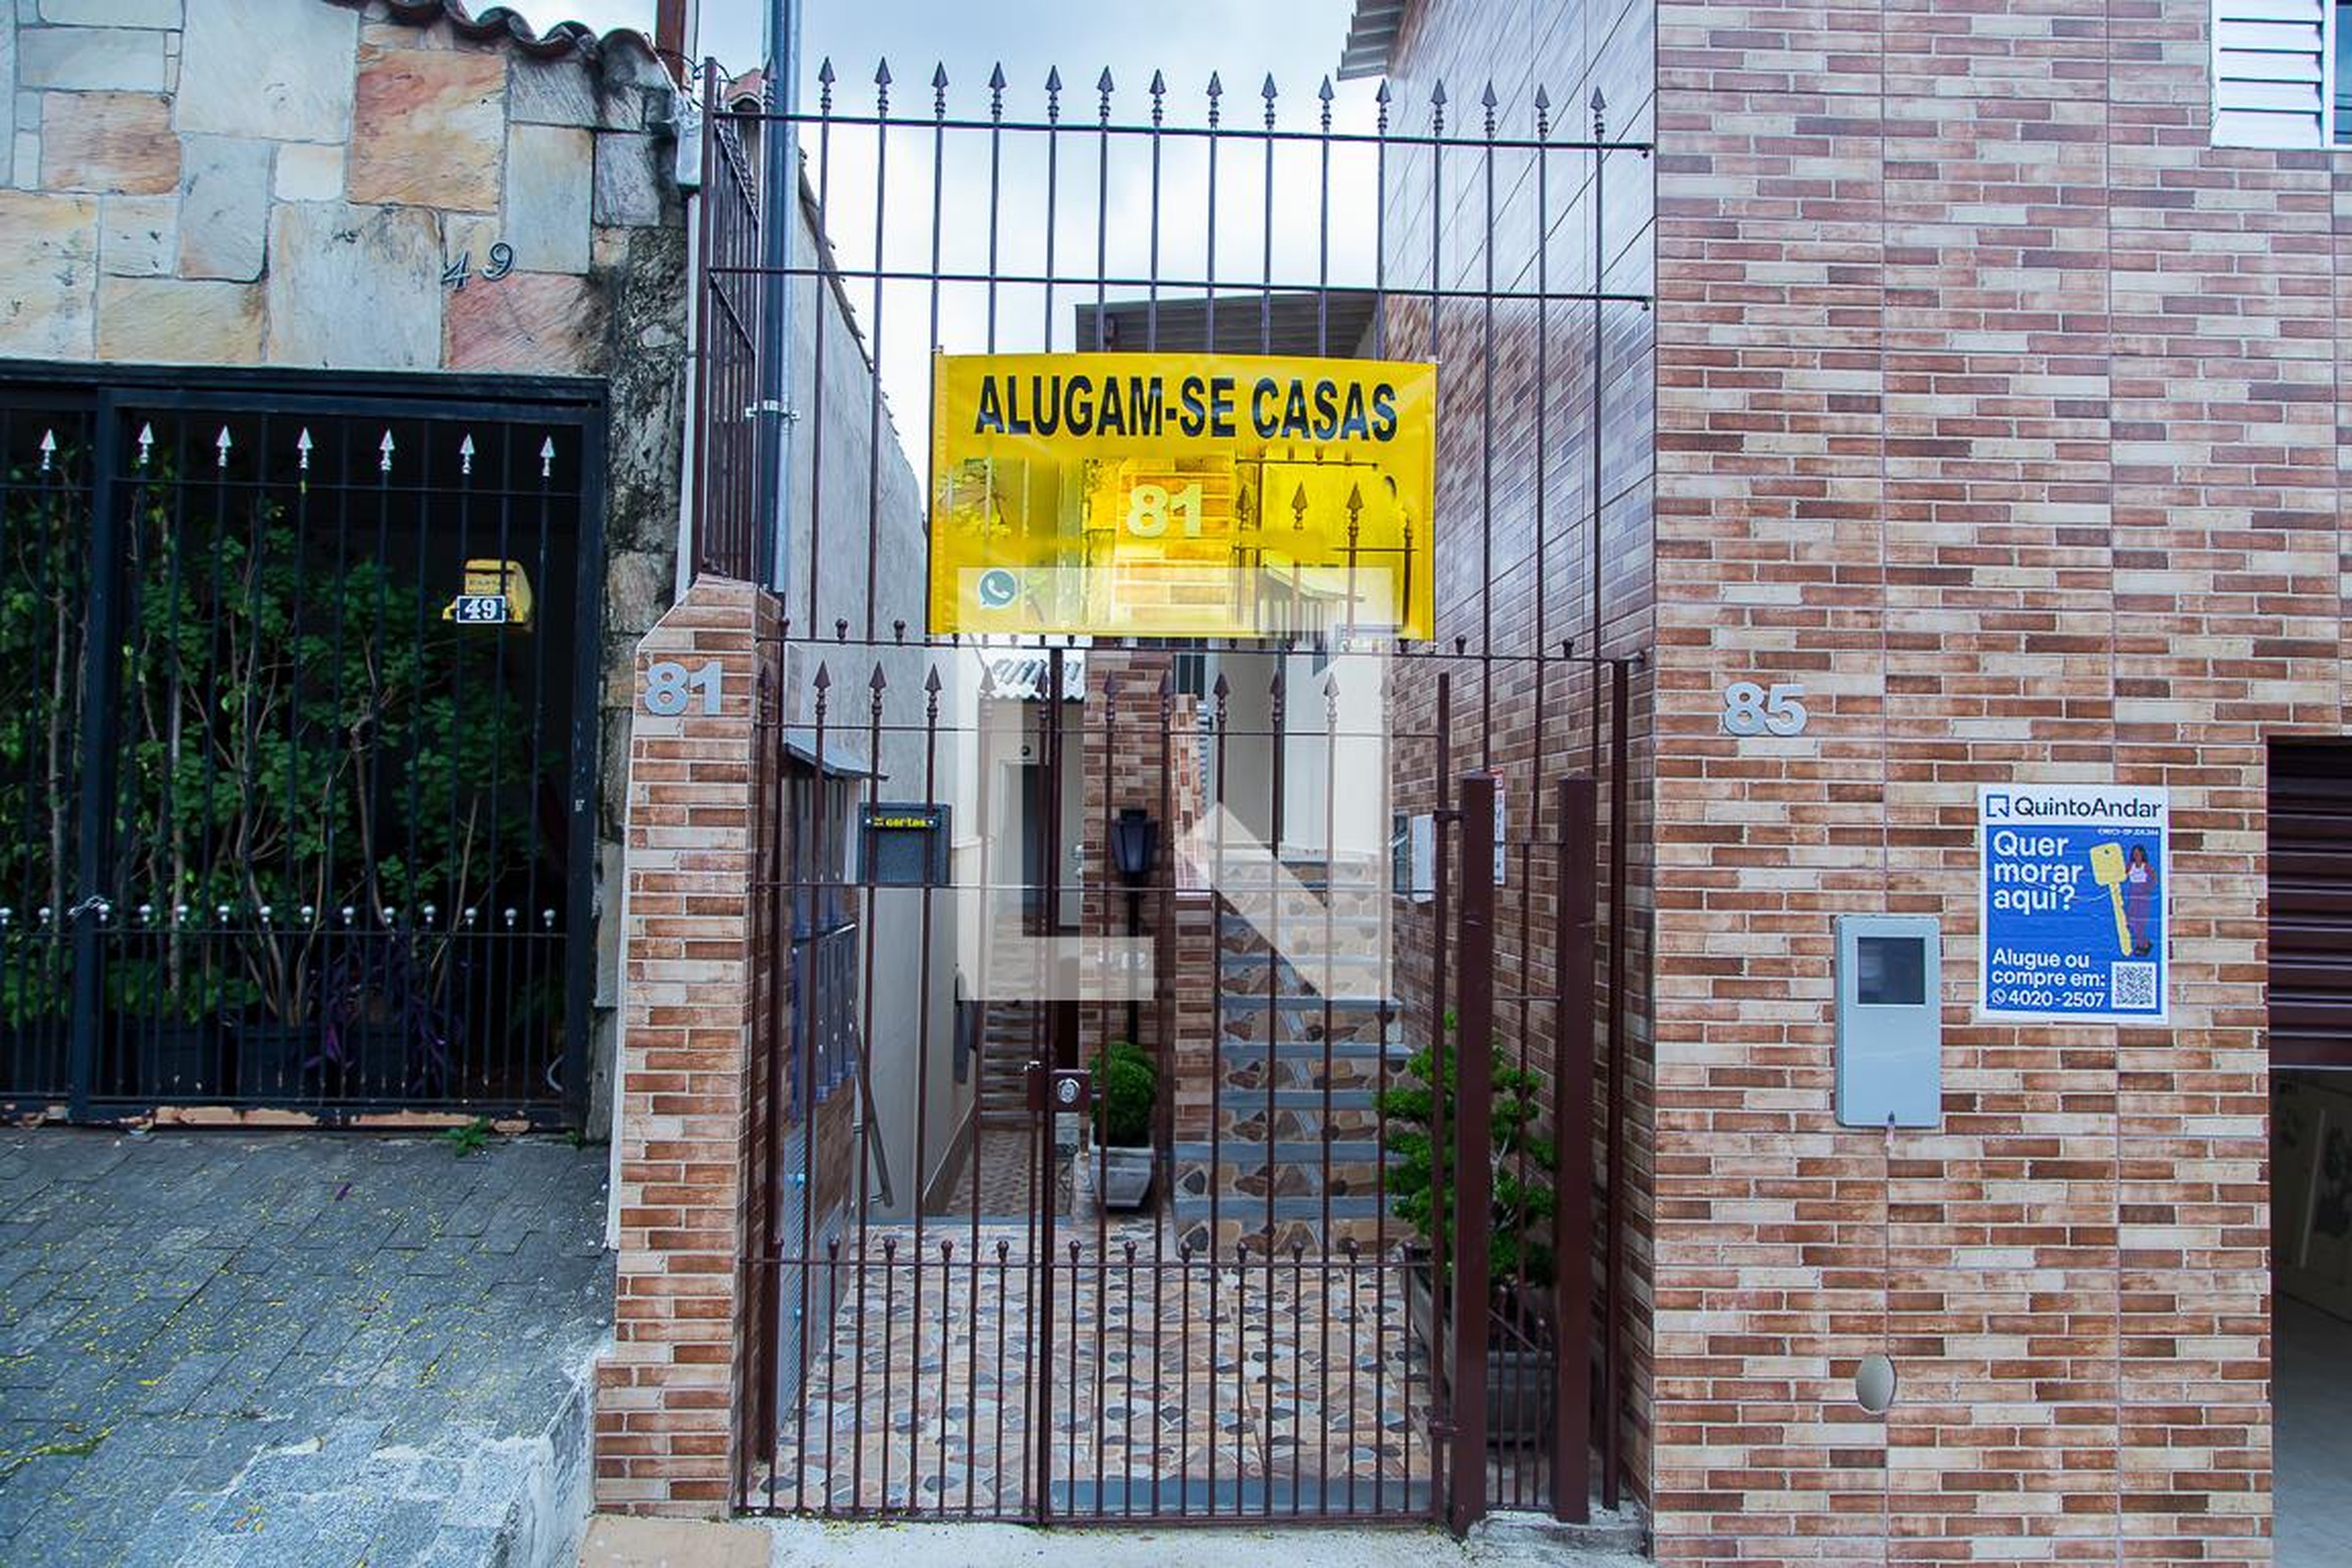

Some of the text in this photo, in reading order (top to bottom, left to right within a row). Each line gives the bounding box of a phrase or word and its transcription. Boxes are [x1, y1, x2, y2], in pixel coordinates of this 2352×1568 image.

[441, 243, 513, 290] 49
[974, 375, 1398, 442] ALUGAM-SE CASAS
[1126, 483, 1204, 538] 81
[465, 599, 497, 619] 49
[645, 662, 722, 715] 81
[1725, 682, 1807, 736] 85
[2014, 797, 2162, 818] QuintoAndar
[1993, 831, 2069, 857] Quer
[1993, 862, 2083, 884] morar
[1993, 885, 2075, 915] aqui?
[1992, 948, 2090, 968] Alugue ou
[1992, 970, 2106, 988] compre em:
[2008, 990, 2105, 1008] 4020-2507
